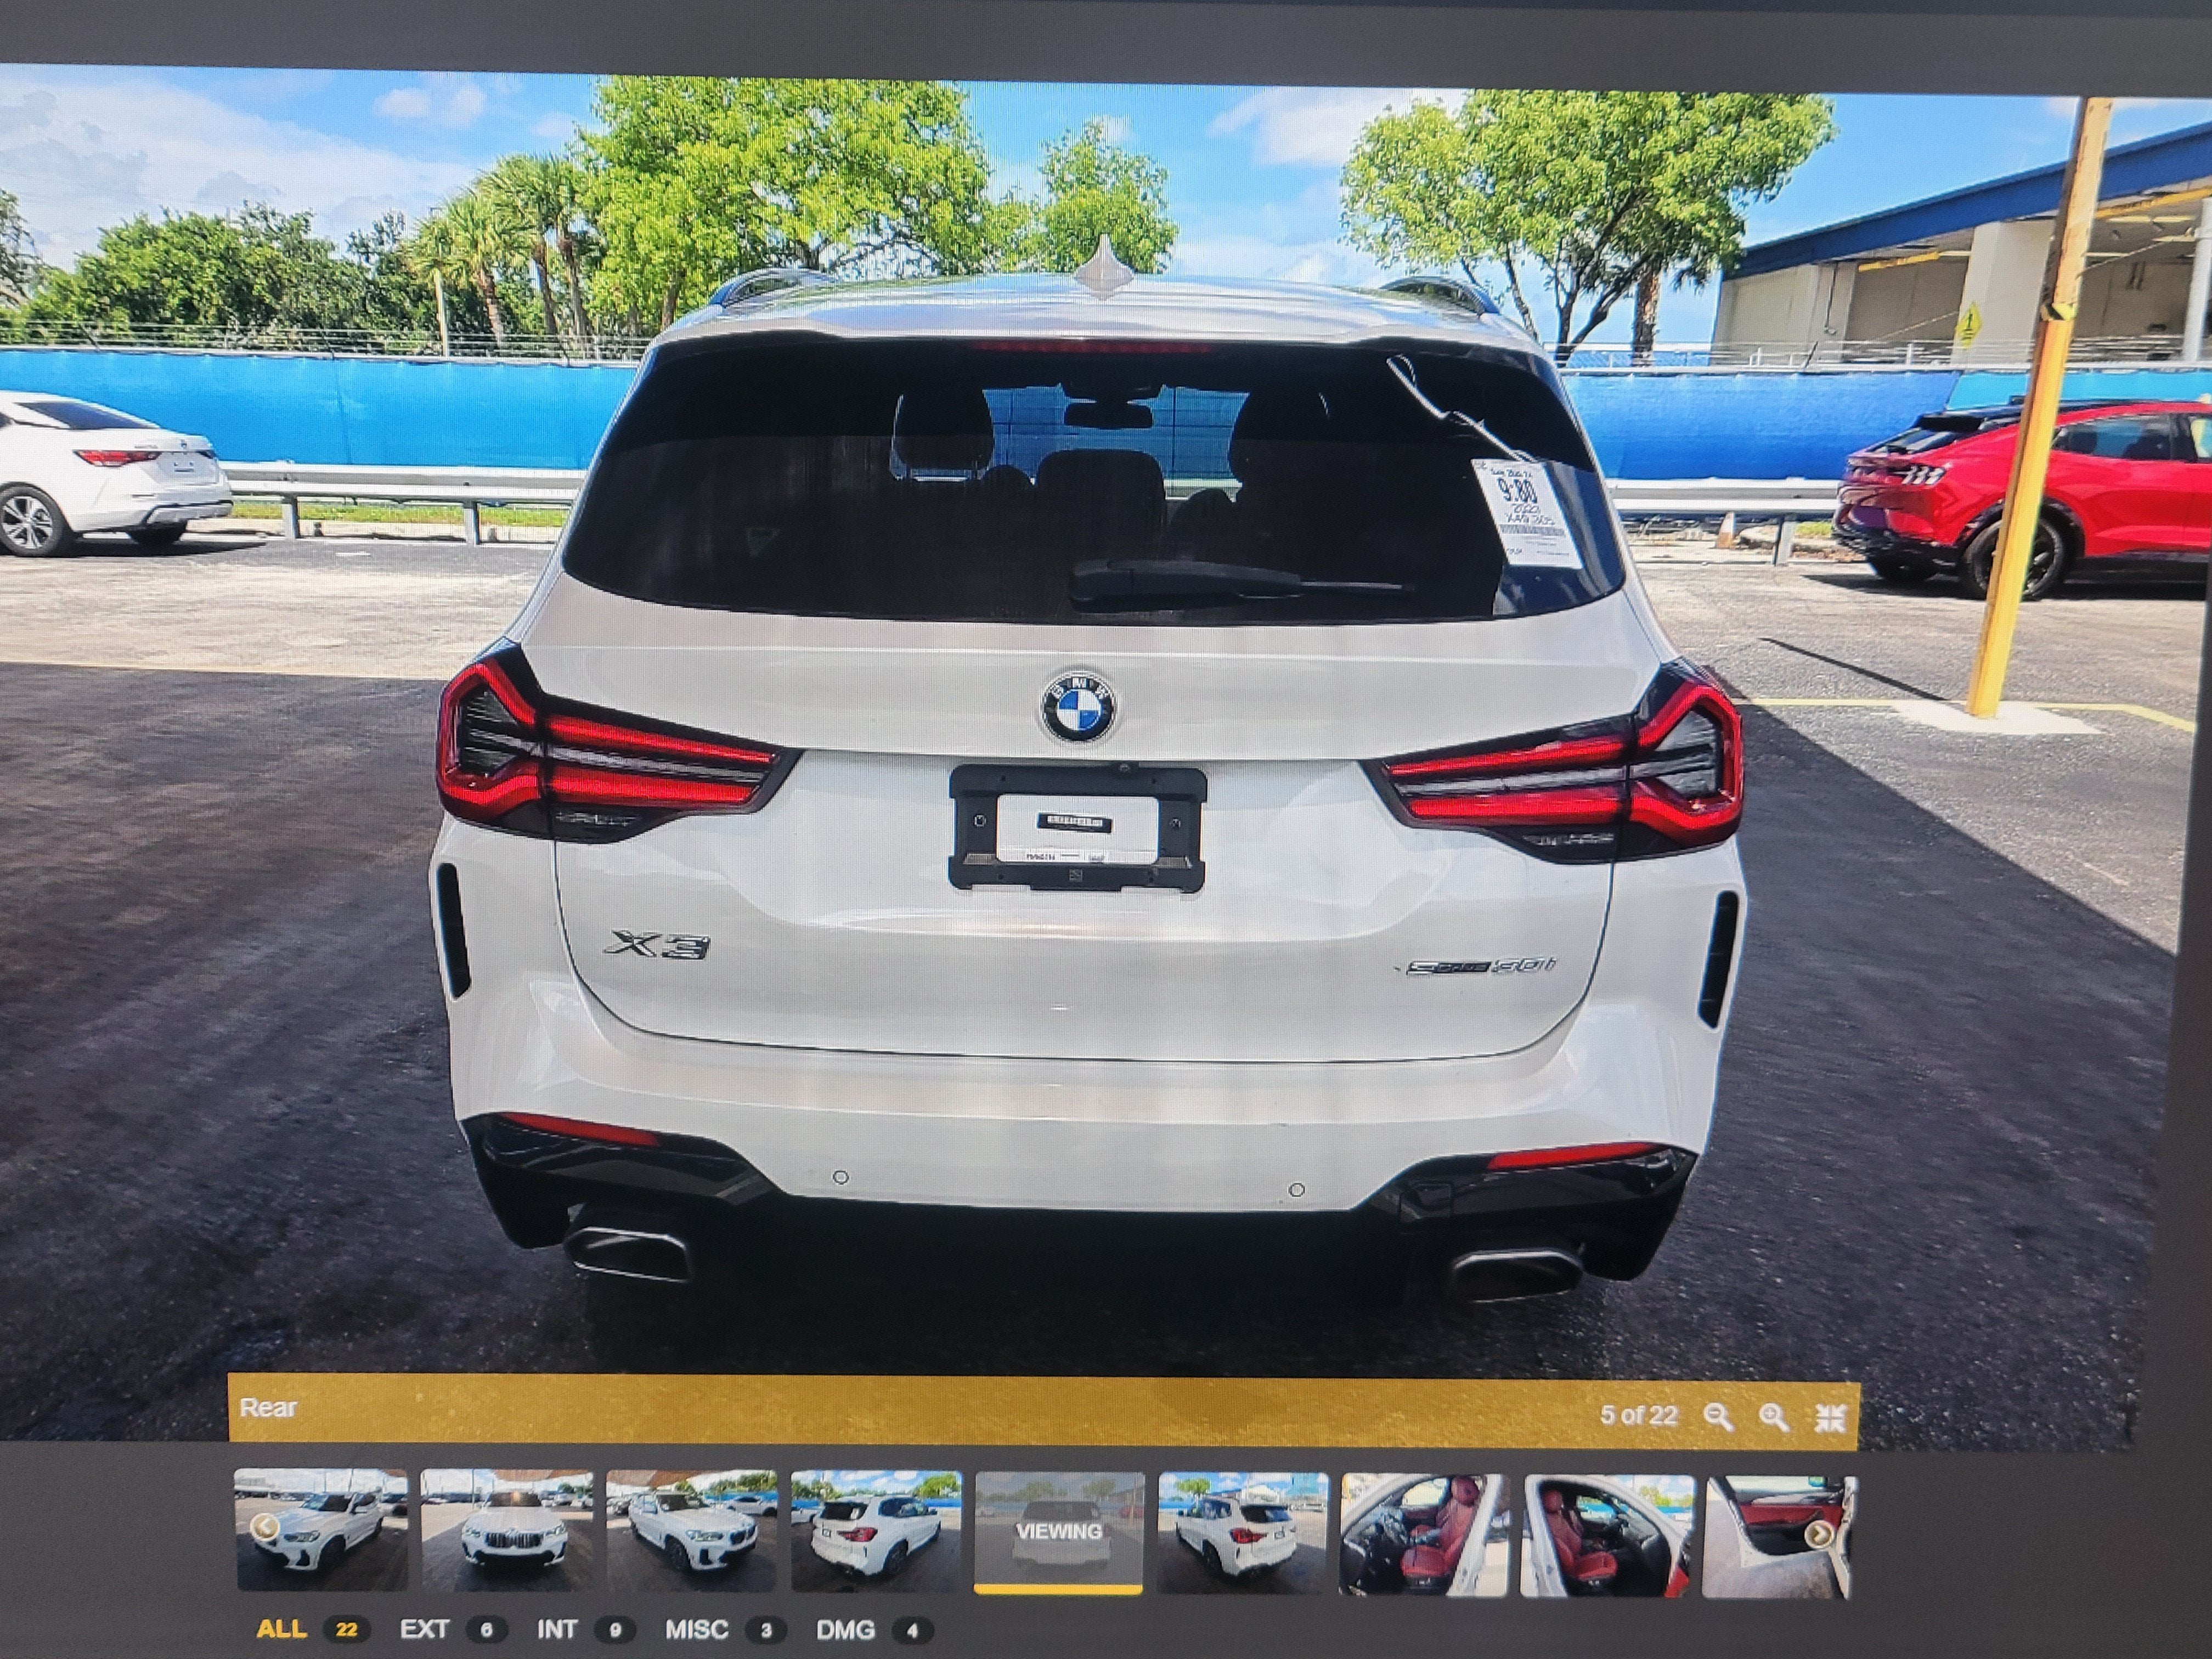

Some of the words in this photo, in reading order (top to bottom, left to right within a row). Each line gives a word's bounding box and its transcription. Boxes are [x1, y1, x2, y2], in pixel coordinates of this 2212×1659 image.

[1050, 677, 1111, 701] BMW
[602, 929, 711, 961] X3
[240, 1397, 298, 1418] Rear
[1601, 1404, 1616, 1425] 5
[1621, 1404, 1645, 1425] of
[1650, 1405, 1679, 1426] 22
[1016, 1523, 1104, 1539] VIEWING
[256, 1619, 308, 1639] ALL
[335, 1622, 358, 1637] 22
[400, 1619, 450, 1639] EXT
[538, 1619, 578, 1639] INT
[666, 1619, 729, 1639] MISC
[761, 1623, 772, 1639] 3
[817, 1620, 876, 1639] DMG
[906, 1623, 919, 1638] 4
